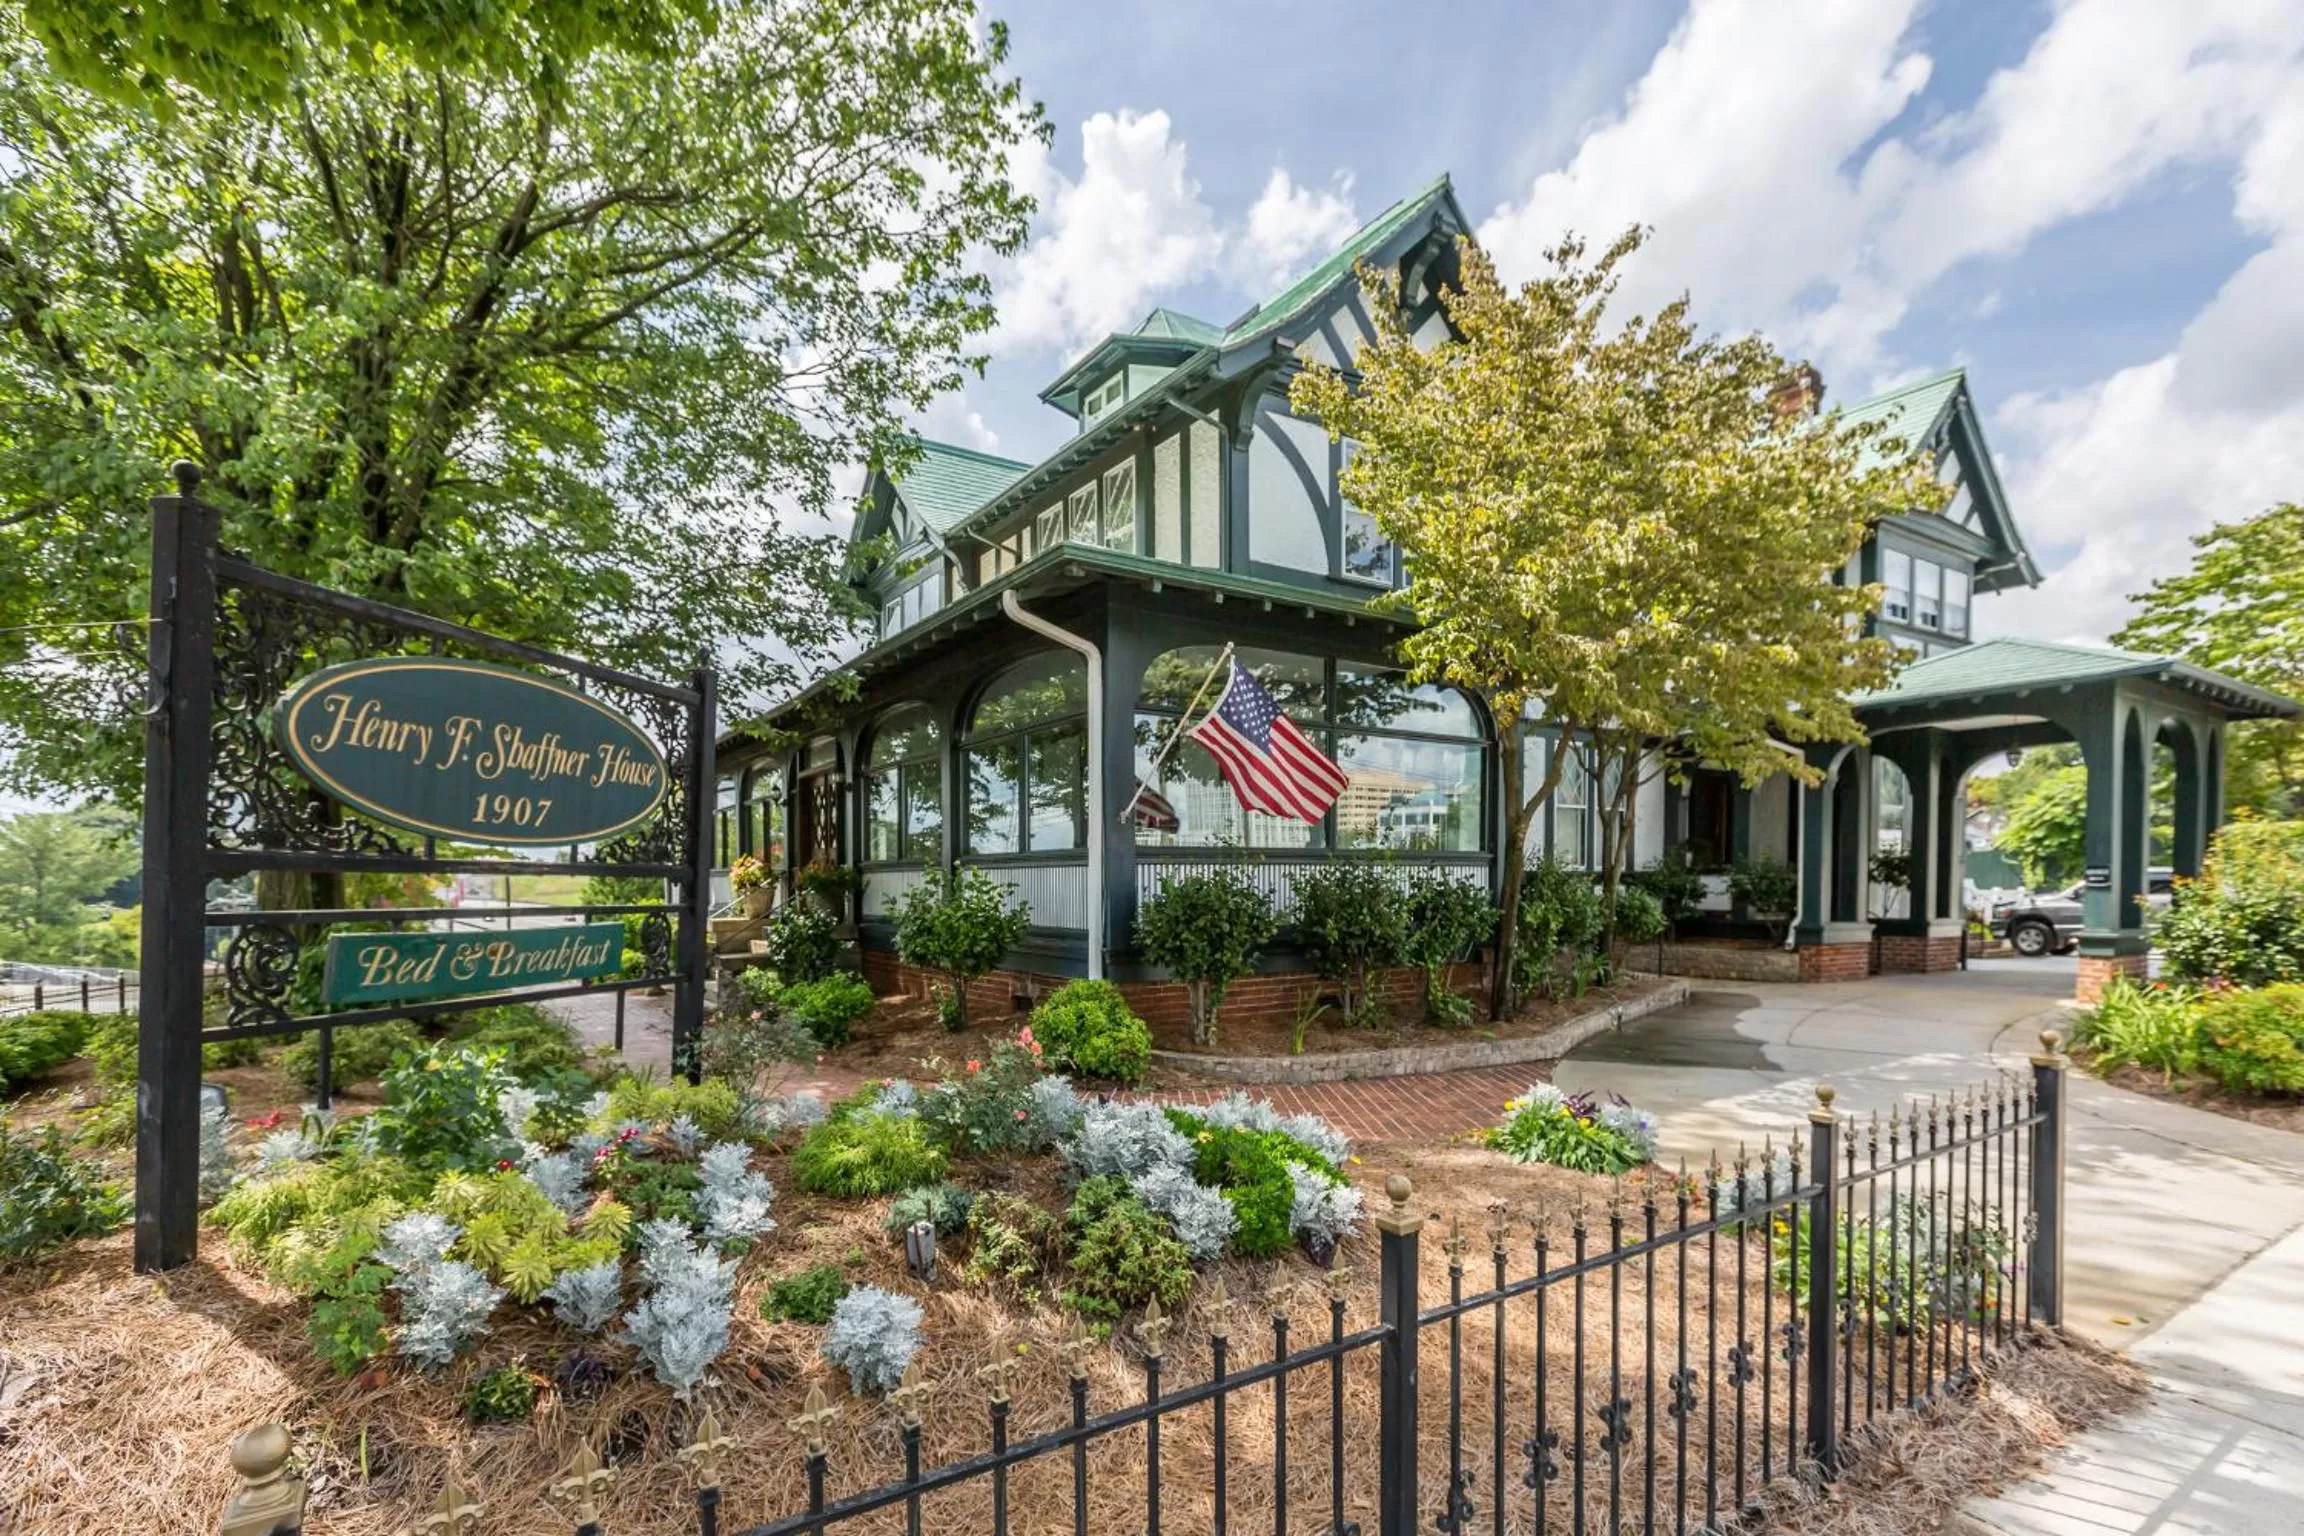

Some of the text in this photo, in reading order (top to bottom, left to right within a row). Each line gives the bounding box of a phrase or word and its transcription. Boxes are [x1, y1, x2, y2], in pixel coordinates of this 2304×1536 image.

[310, 694, 657, 788] Henry F. Shaffner House
[472, 793, 552, 827] 1907
[358, 936, 612, 987] Bed & Breakfast
